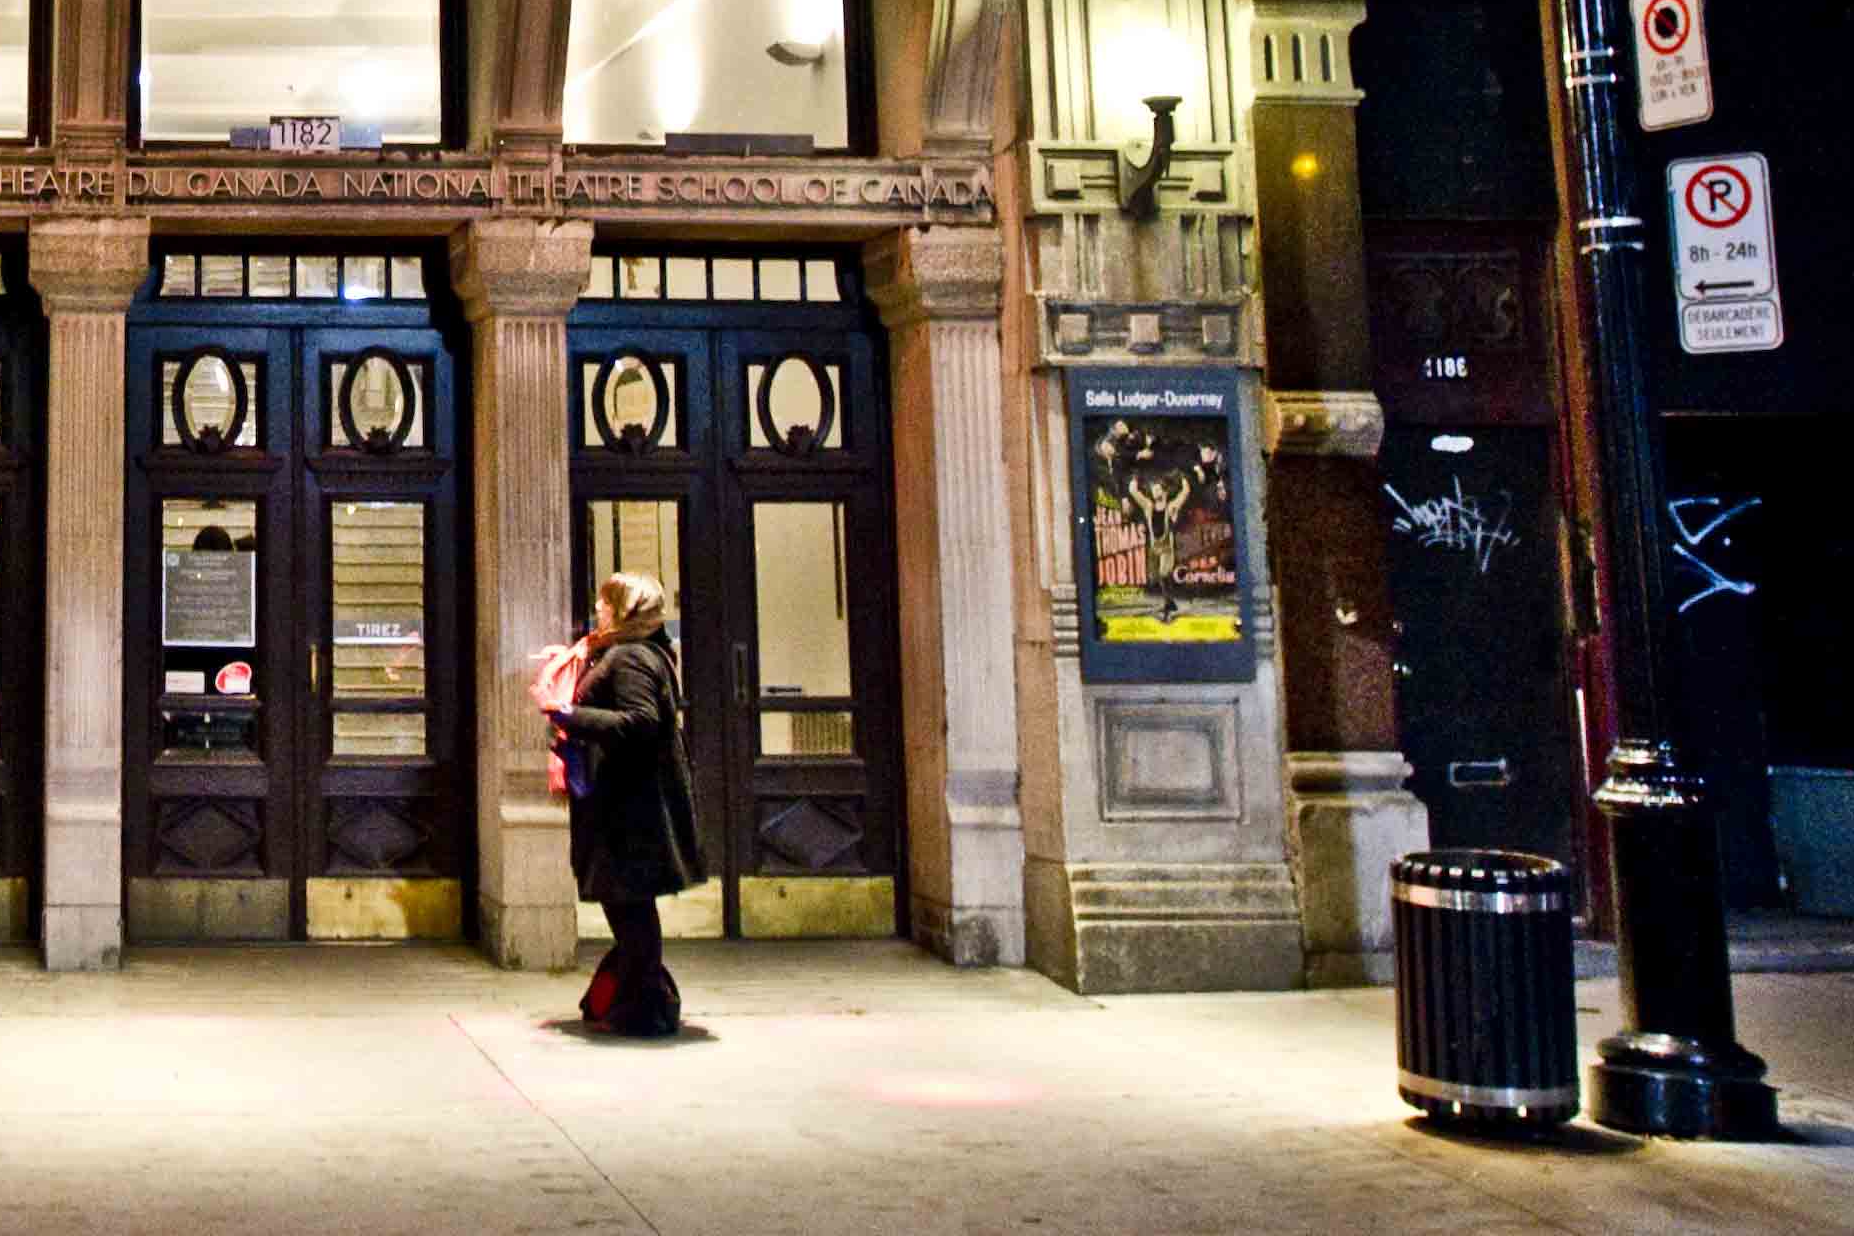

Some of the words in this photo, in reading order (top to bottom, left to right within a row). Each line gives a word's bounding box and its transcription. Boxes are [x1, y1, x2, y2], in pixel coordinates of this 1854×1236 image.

[278, 121, 333, 147] 1182
[128, 171, 174, 197] DU
[186, 171, 324, 197] CANADA
[507, 172, 644, 200] THEATRE
[656, 176, 792, 203] SCHOOL
[803, 177, 848, 204] OF
[859, 178, 994, 206] CANADA
[1689, 244, 1711, 264] 8h
[1725, 240, 1758, 262] 24h
[1085, 389, 1116, 407] Salle
[1095, 523, 1147, 556] THOMAS
[355, 622, 402, 638] TIREZ
